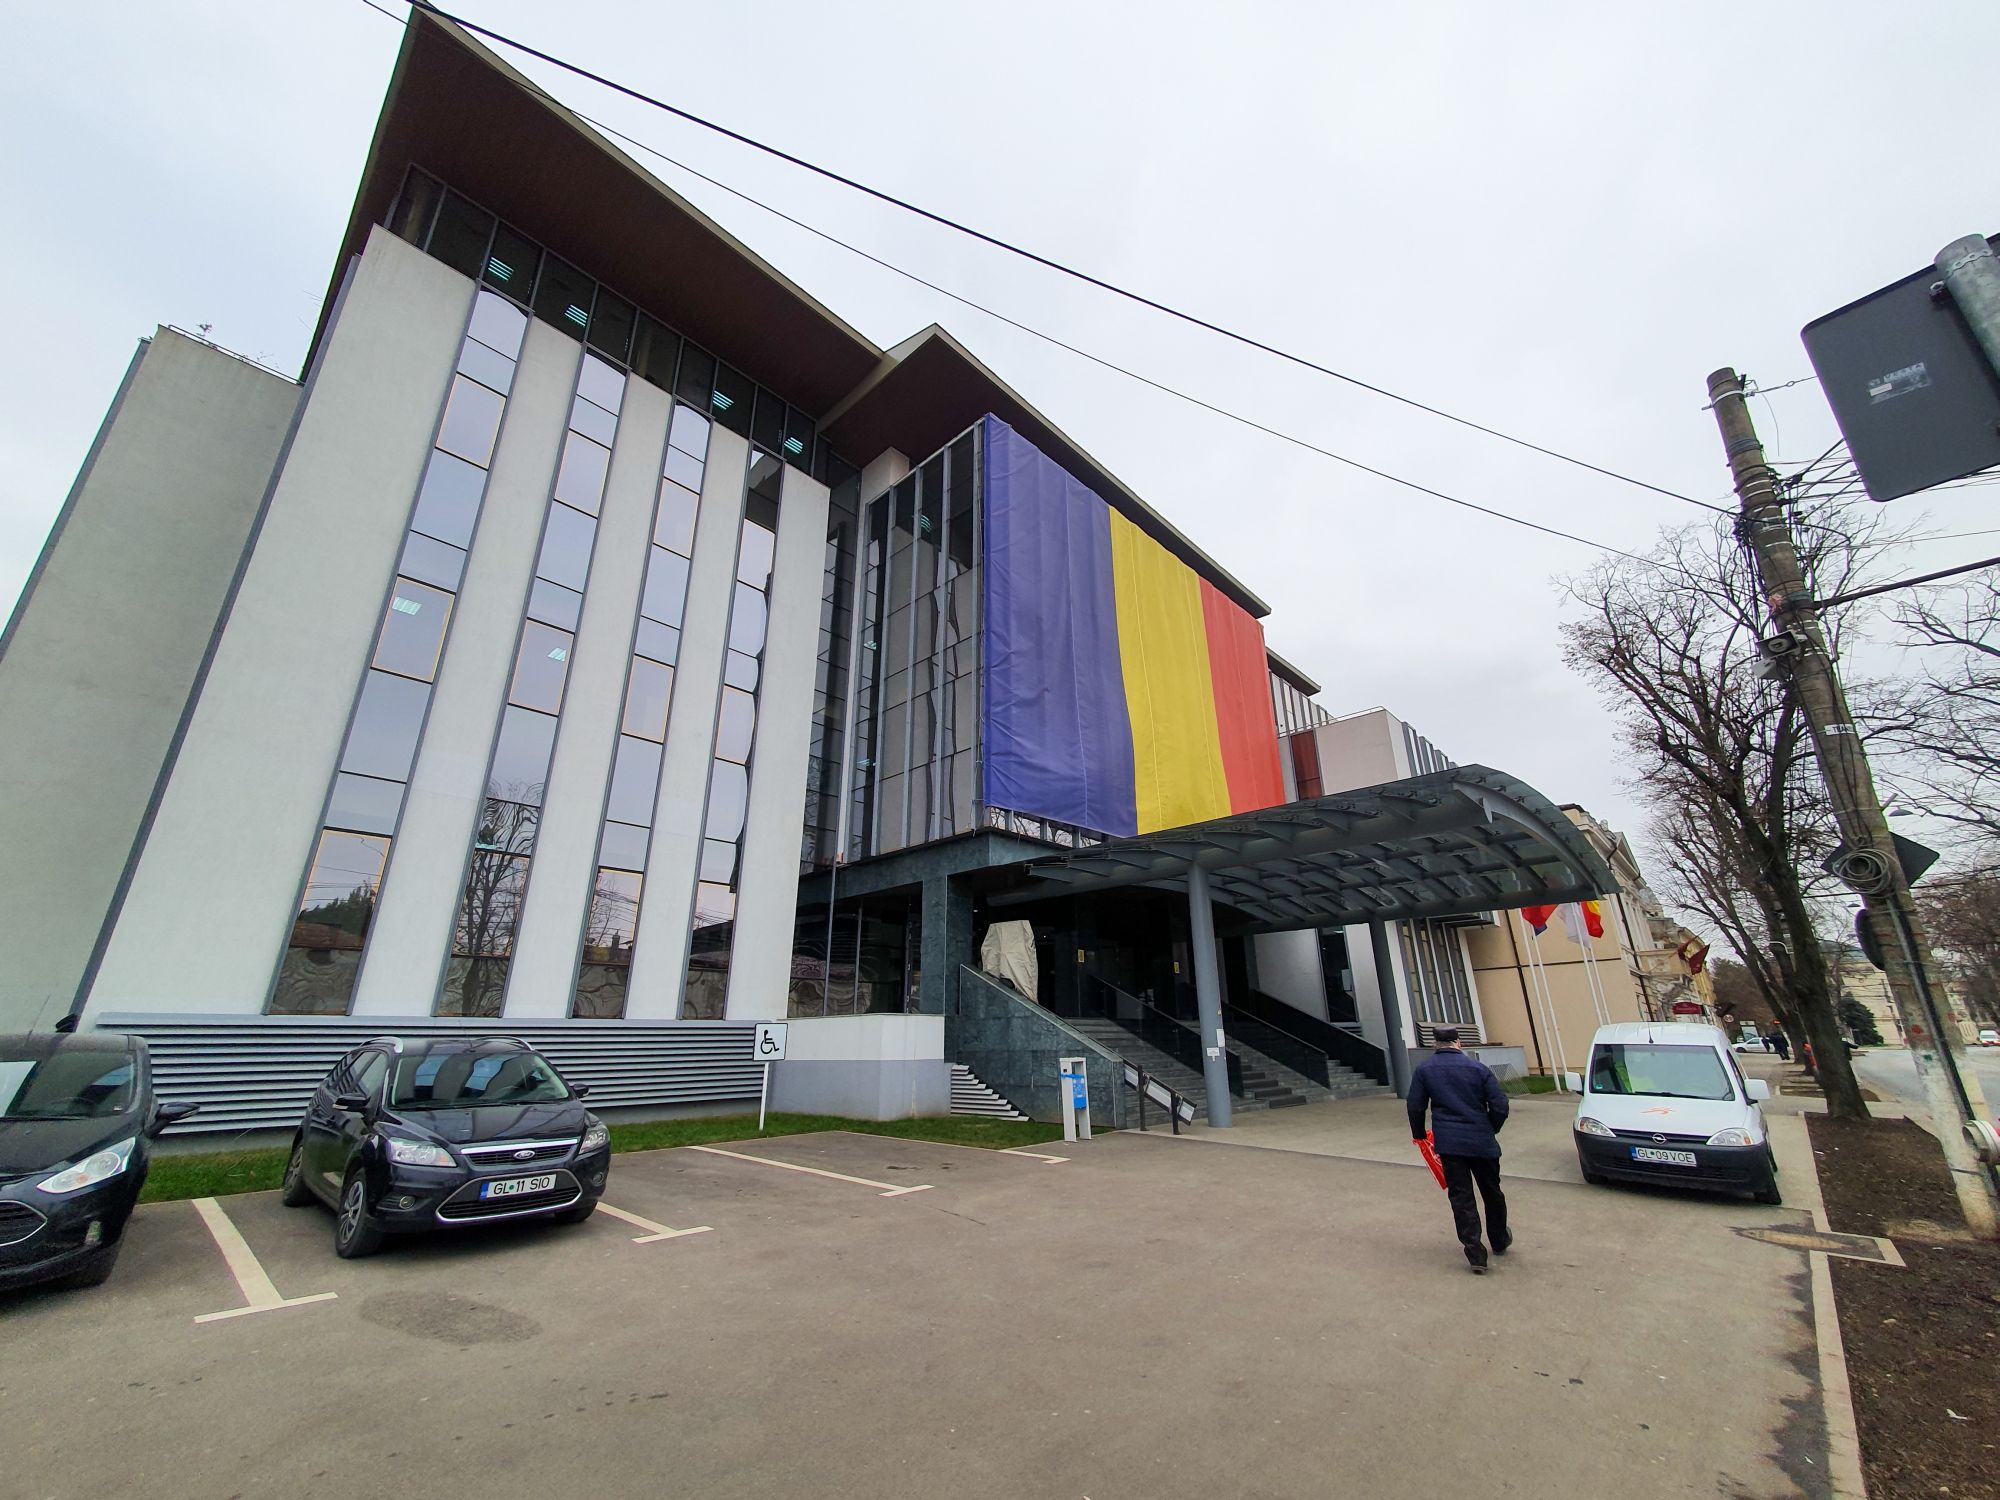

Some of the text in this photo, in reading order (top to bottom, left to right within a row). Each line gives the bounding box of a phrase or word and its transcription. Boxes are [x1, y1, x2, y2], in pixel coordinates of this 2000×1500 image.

[1638, 1149, 1693, 1163] GL 09 VOE
[493, 1177, 550, 1195] GL 11 SIO
